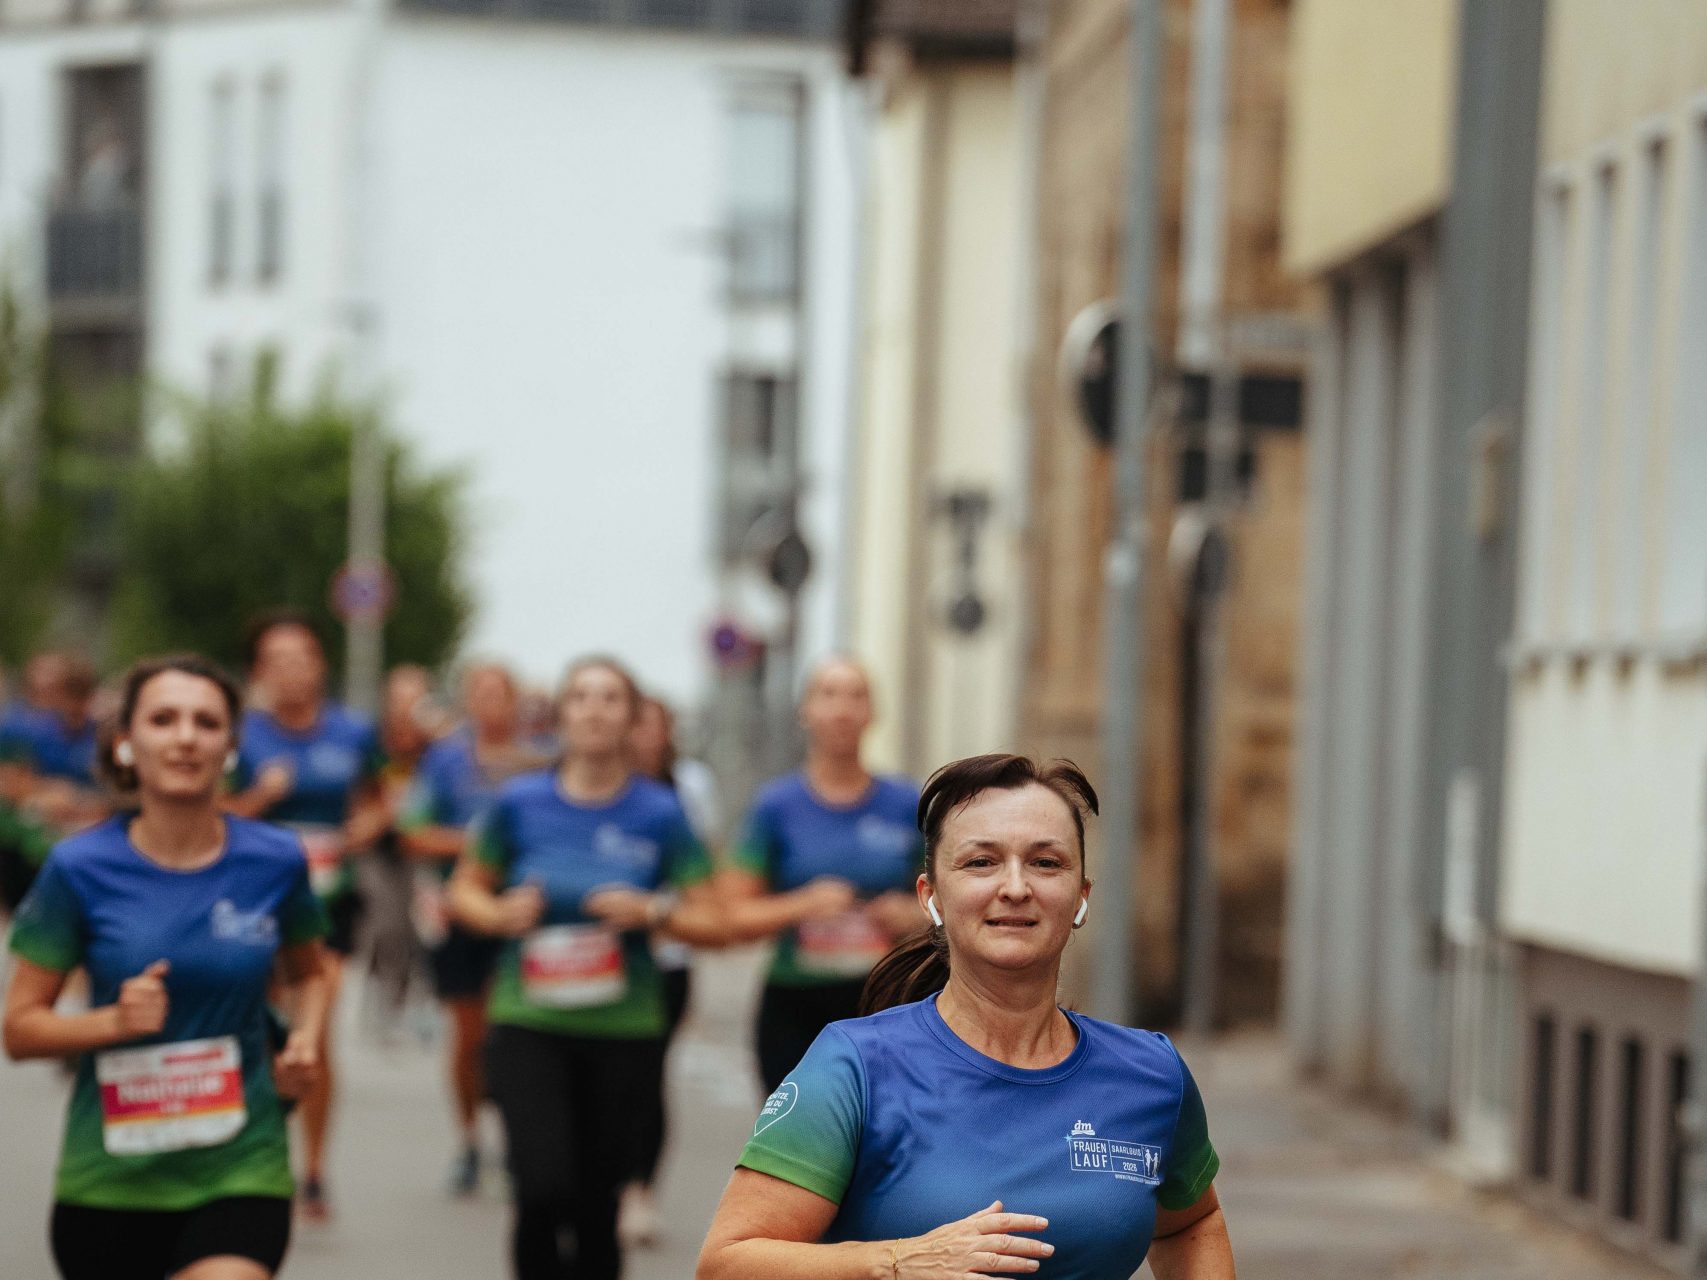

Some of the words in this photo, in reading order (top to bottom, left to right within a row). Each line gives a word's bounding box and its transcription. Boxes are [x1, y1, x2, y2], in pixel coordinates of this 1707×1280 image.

[1074, 1120, 1092, 1130] dm
[1073, 1141, 1107, 1153] FRAUEN
[1111, 1145, 1142, 1157] SAARLOUIS
[1075, 1153, 1108, 1168] LAUF
